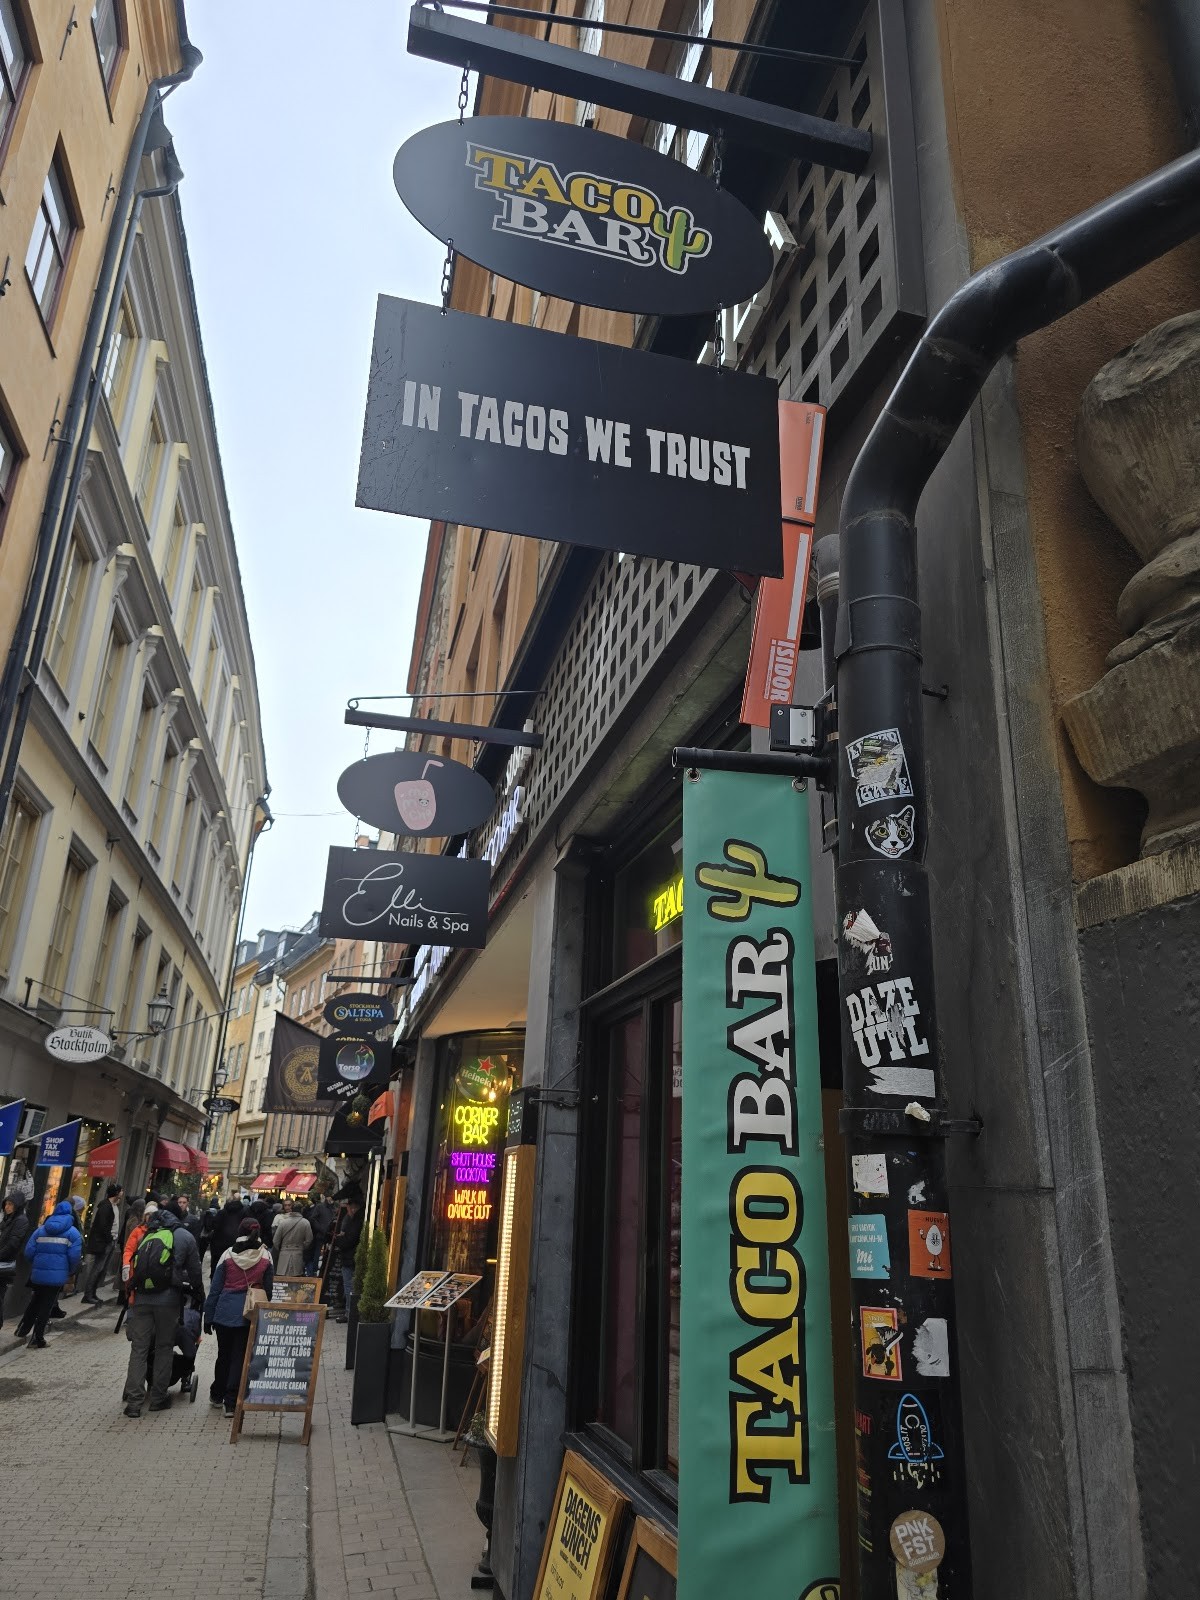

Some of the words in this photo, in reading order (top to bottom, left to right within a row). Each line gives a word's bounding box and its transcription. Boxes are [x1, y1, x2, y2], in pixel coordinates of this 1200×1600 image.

[470, 147, 656, 225] TACO
[499, 193, 653, 265] BAR
[402, 381, 441, 431] IN
[458, 391, 569, 455] TACOS
[585, 415, 632, 468] WE
[646, 429, 750, 489] TRUST
[336, 863, 466, 926] Elli
[388, 912, 423, 929] Nails
[427, 915, 438, 930] &
[442, 917, 469, 933] Spa
[338, 1006, 384, 1019] SALTSPA
[69, 1027, 94, 1039] Butik
[730, 928, 797, 1152] BAR
[49, 1036, 109, 1055] Stockholm
[338, 1063, 361, 1073] Torso
[462, 1068, 493, 1088] Heinek
[455, 1105, 499, 1126] CORNER
[45, 1136, 65, 1144] SHOP
[462, 1124, 489, 1145] BAR
[451, 1152, 472, 1167] SHOT
[472, 1153, 496, 1168] HOUSE
[455, 1189, 477, 1204] WALK
[478, 1190, 487, 1204] IN
[448, 1204, 474, 1219] DANCE
[474, 1205, 491, 1219] OUT
[263, 1310, 289, 1321] CORNER
[267, 1325, 284, 1335] IRISH
[285, 1325, 307, 1336] COFFEE
[729, 1166, 805, 1502] TACO
[258, 1335, 279, 1346] KAFFE
[280, 1335, 312, 1346] KARLSSON
[255, 1345, 268, 1356] HOT
[270, 1346, 286, 1356] WINE
[292, 1345, 311, 1357] GLÖGG
[268, 1357, 296, 1368] HOTSHOT
[264, 1368, 296, 1379] LUMUMBA
[288, 1381, 307, 1390] CREAM
[564, 1487, 602, 1544] DAGENS
[894, 1517, 935, 1544] PNK
[560, 1516, 593, 1571] LUNCH
[901, 1535, 935, 1560] FST
